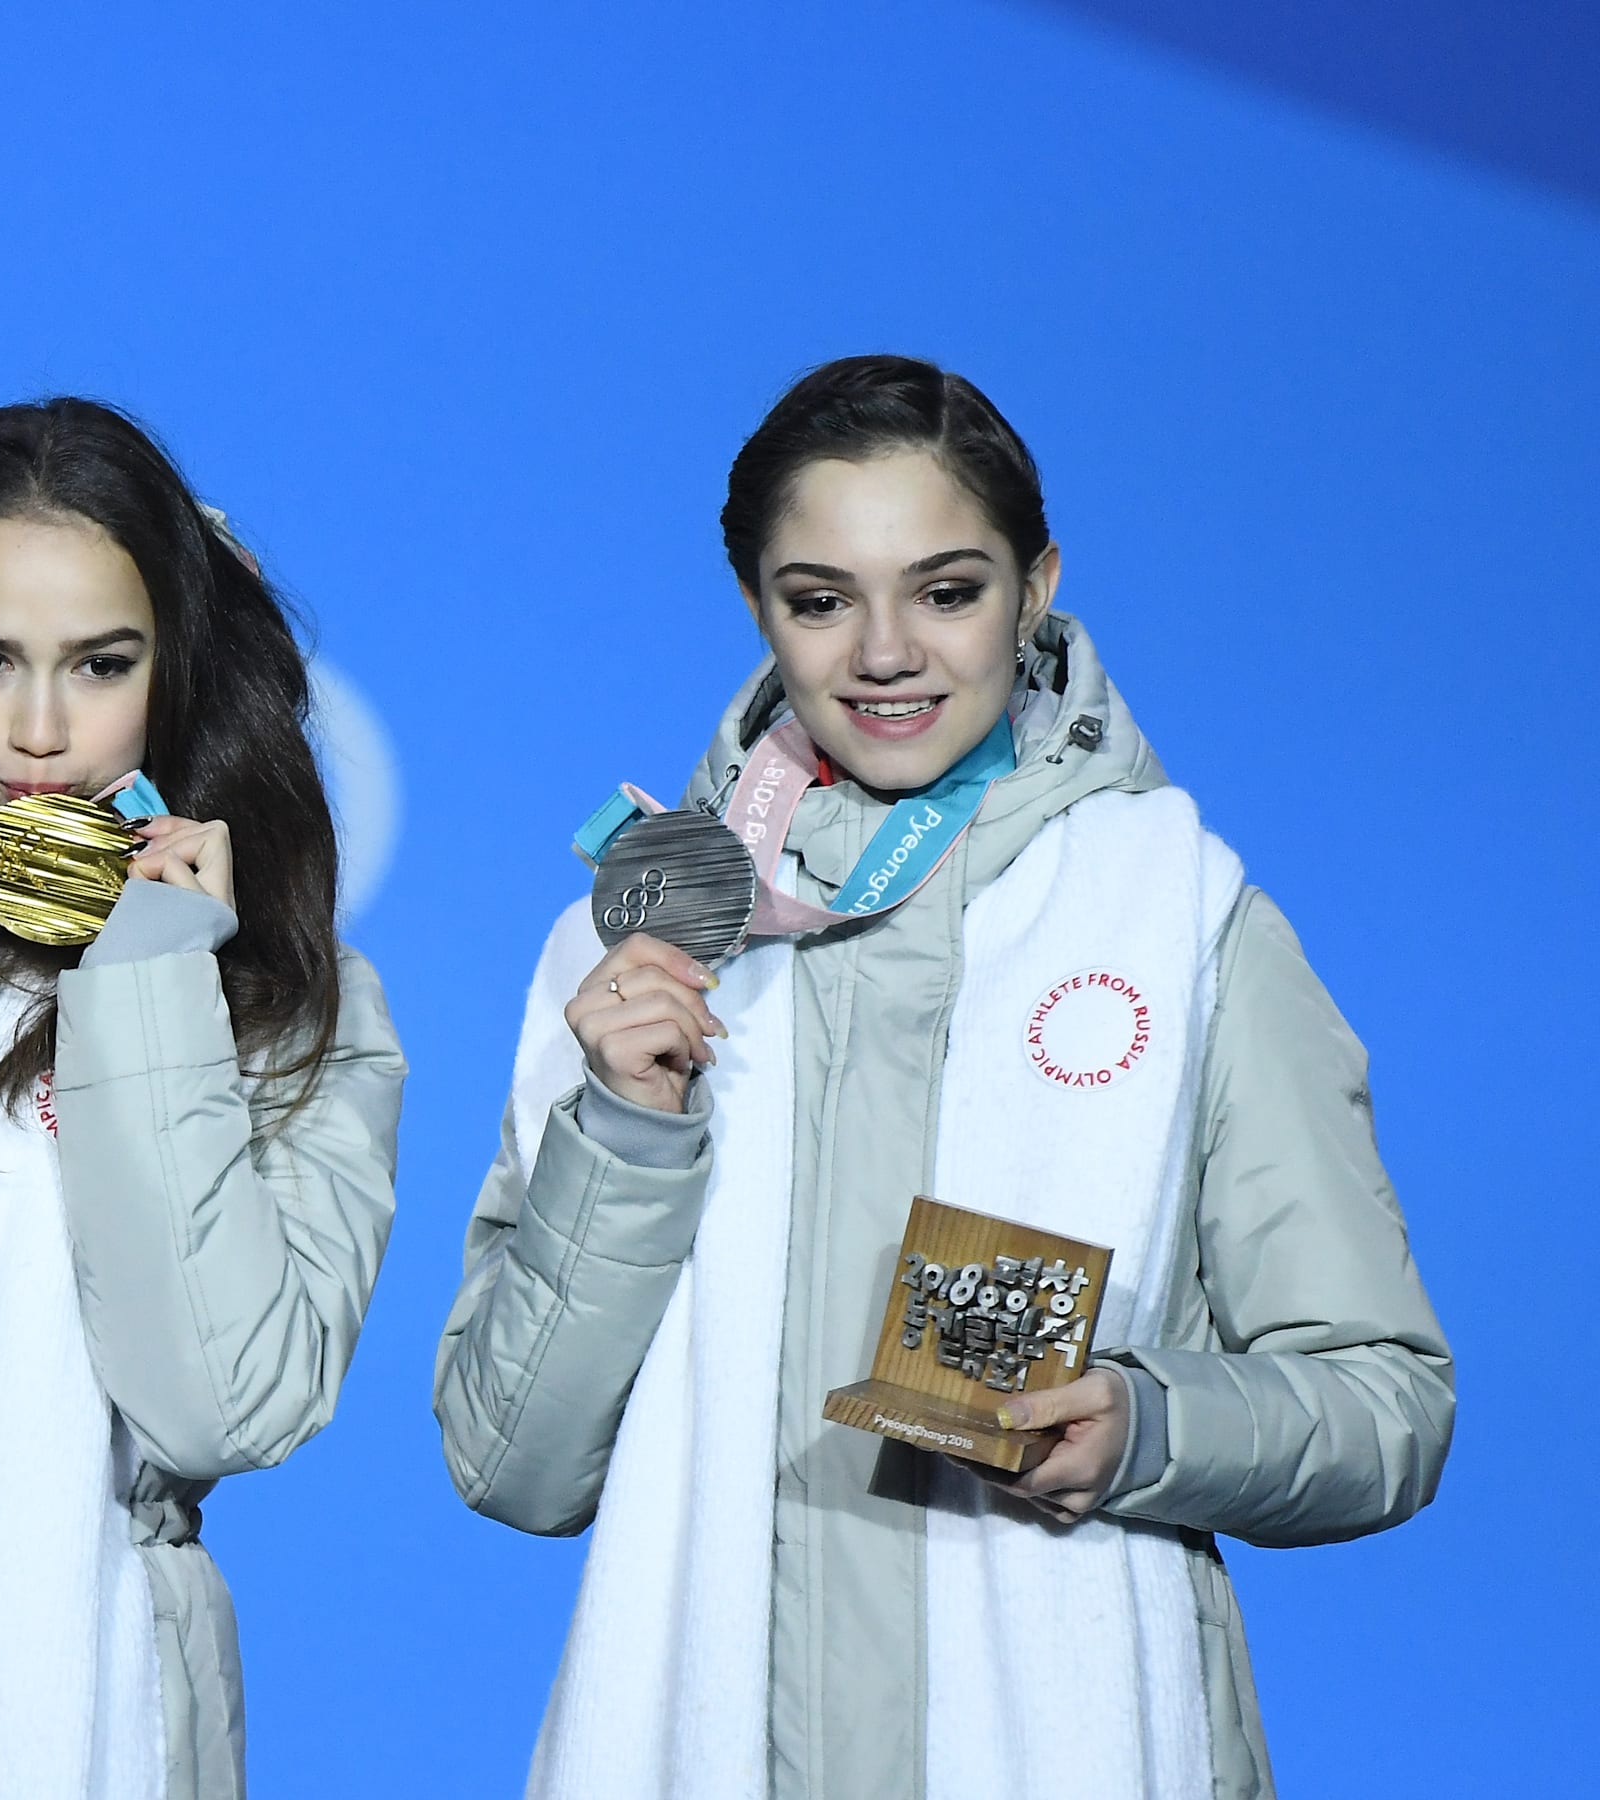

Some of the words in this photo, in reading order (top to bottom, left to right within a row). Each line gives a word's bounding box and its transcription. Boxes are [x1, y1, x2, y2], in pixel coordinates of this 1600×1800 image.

[747, 767, 786, 818] 2018
[1028, 977, 1082, 1044] ATHLETE
[1088, 973, 1141, 1003] FROM
[1115, 1005, 1151, 1070] RUSSIA
[1031, 1048, 1111, 1087] OLYMPIC
[874, 1414, 948, 1445] PyeongChang
[947, 1434, 974, 1450] 2018
